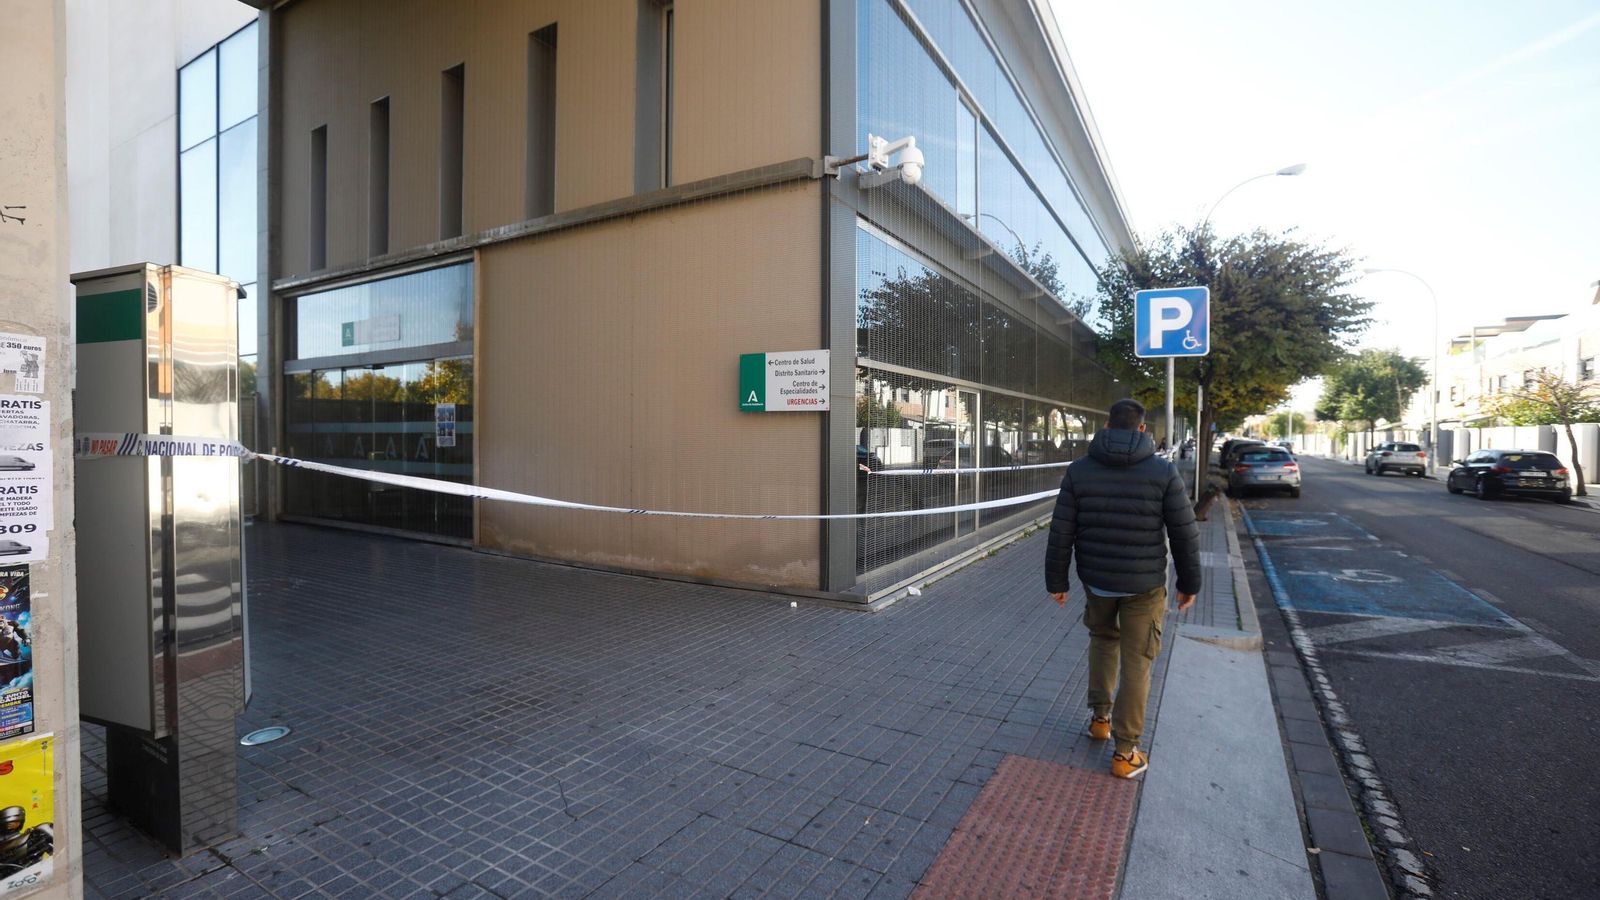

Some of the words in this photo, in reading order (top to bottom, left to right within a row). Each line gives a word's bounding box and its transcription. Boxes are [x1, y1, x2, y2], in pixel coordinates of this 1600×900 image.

[1150, 297, 1193, 349] P
[6, 341, 22, 349] 350
[800, 357, 815, 365] Salud
[780, 388, 818, 396] Especialidades
[144, 440, 196, 456] NACIONAL
